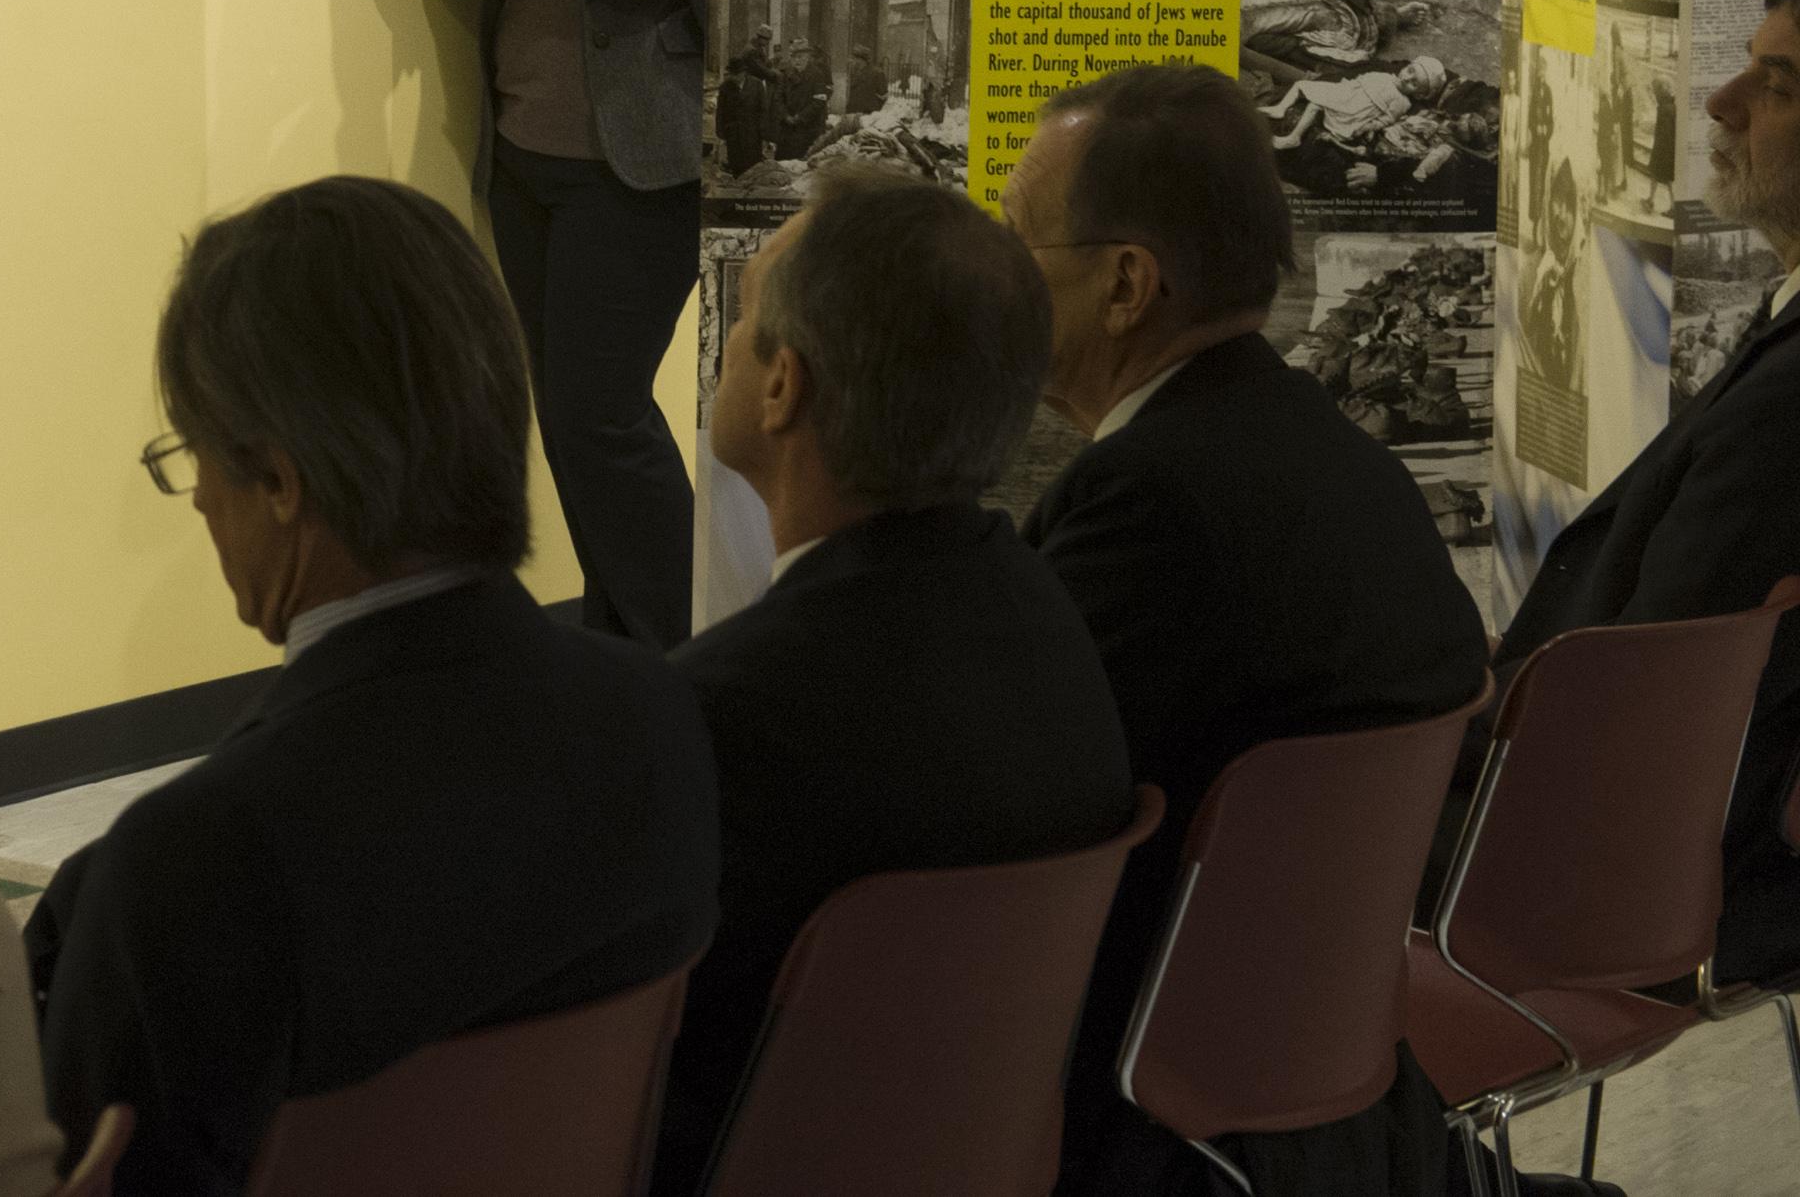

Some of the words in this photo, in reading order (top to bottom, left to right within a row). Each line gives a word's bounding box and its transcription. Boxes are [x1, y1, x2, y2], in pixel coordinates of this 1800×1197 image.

[990, 1, 1011, 18] the
[1017, 2, 1062, 24] capital
[1069, 2, 1131, 19] thousand
[1137, 2, 1151, 20] of
[1154, 2, 1185, 25] Jews
[1192, 8, 1223, 20] were
[989, 27, 1017, 45] shot
[1023, 28, 1048, 45] and
[1054, 28, 1109, 51] dumped
[1115, 28, 1141, 46] into
[1148, 29, 1169, 46] the
[1176, 29, 1226, 46] Danube
[989, 53, 1026, 71] River.
[1033, 54, 1078, 77] During
[988, 85, 1022, 97] more
[987, 136, 1000, 149] to
[986, 188, 999, 201] to
